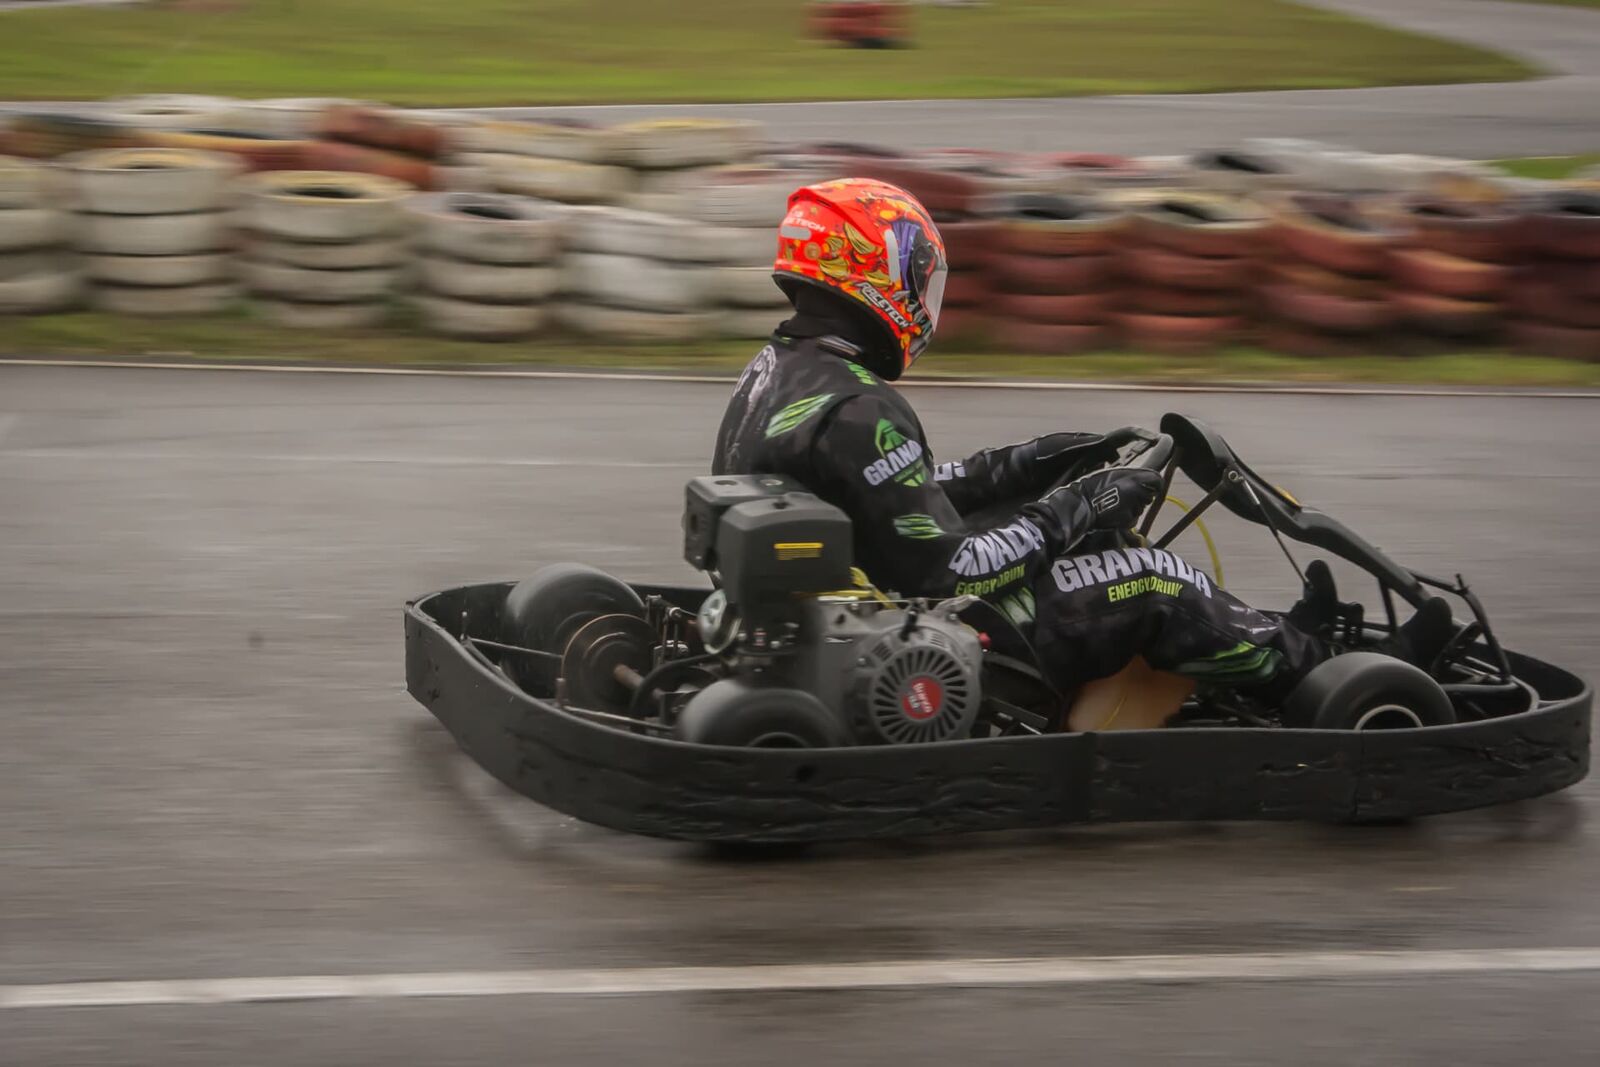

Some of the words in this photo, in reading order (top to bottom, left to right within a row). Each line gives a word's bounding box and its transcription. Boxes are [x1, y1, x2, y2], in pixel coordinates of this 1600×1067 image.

[854, 281, 910, 328] RACETECH
[1050, 547, 1212, 599] GRANADA
[1107, 576, 1150, 603] ENERGY
